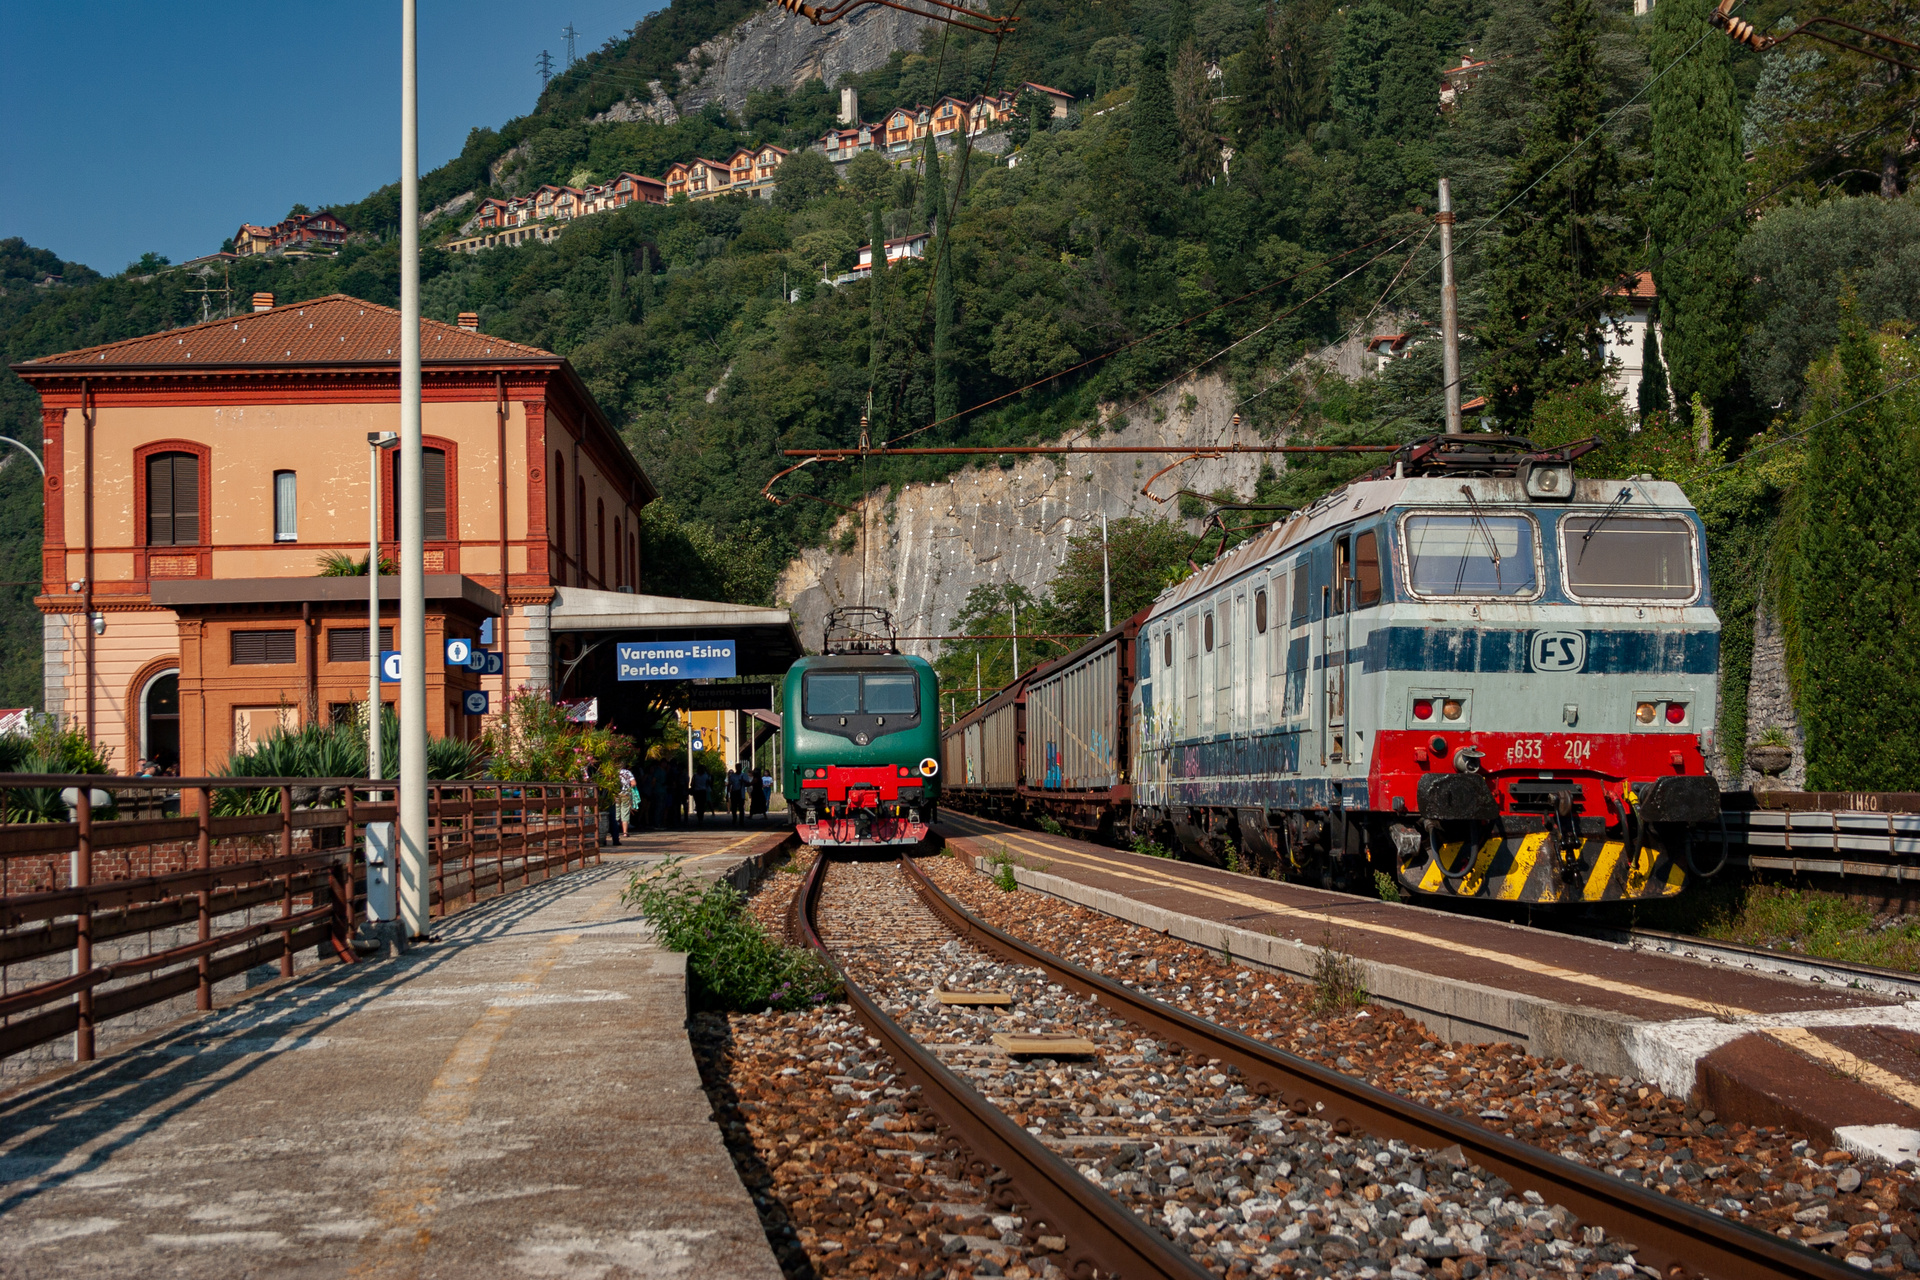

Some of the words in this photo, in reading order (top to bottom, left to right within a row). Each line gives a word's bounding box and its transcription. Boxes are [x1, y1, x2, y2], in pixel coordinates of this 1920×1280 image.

[620, 645, 731, 660] Varenna-Esino
[1540, 637, 1576, 666] FS
[393, 659, 400, 674] 1
[620, 662, 679, 676] Perledo
[691, 686, 769, 697] Varenna-Esino
[691, 699, 732, 708] Perledo
[1507, 739, 1542, 759] E633
[1564, 740, 1591, 759] 204
